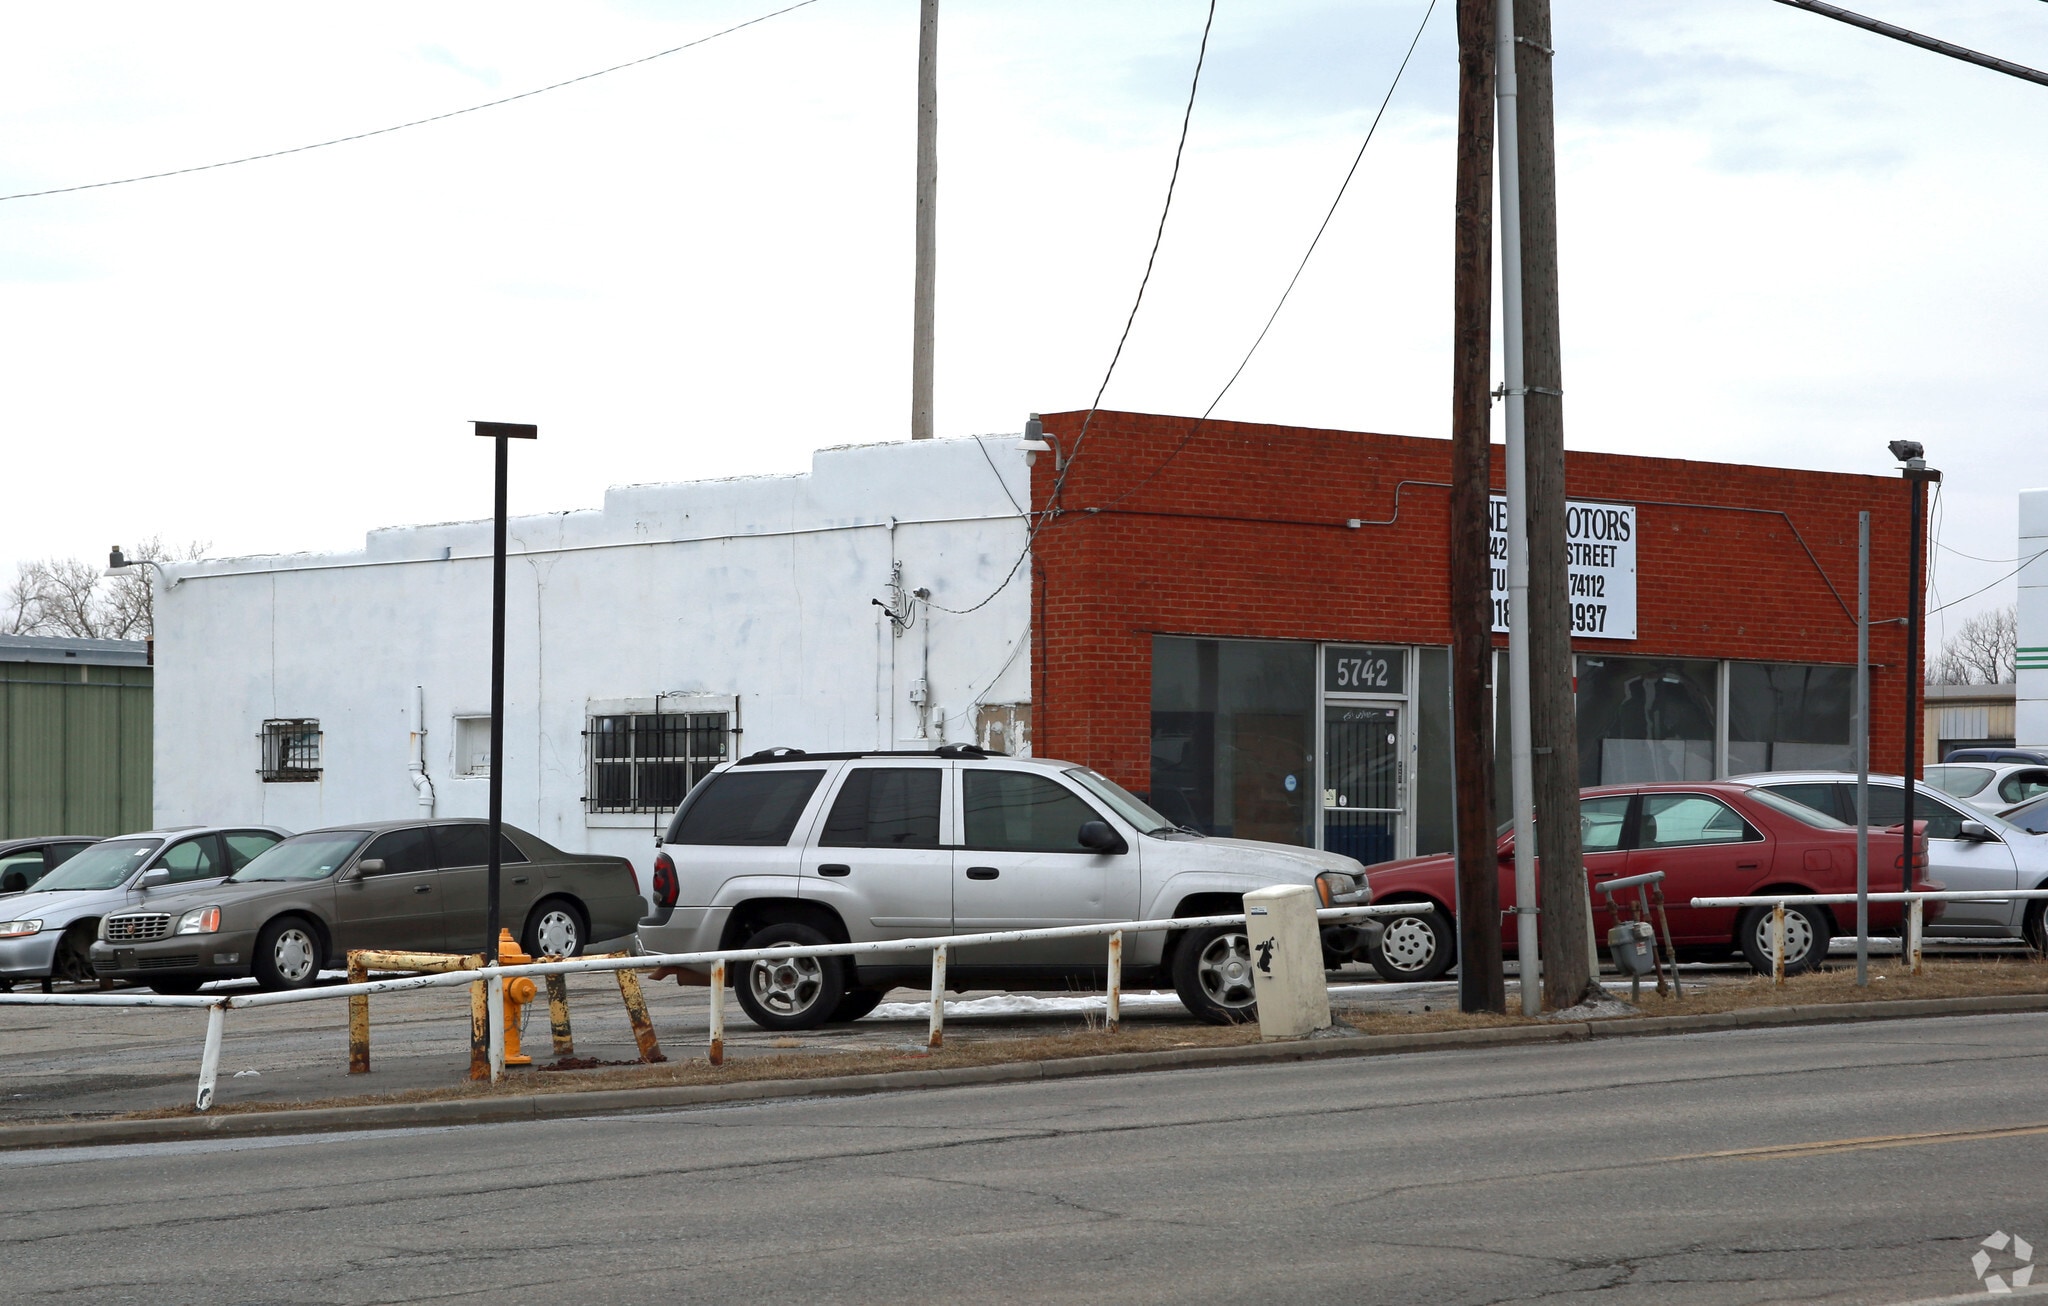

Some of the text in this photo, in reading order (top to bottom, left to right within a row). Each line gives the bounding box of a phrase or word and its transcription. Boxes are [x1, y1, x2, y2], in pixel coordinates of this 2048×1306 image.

[1566, 506, 1631, 542] OTORS
[1490, 536, 1617, 568] 42 STREET
[1490, 568, 1605, 598] TU 74112
[1337, 658, 1388, 687] 5742
